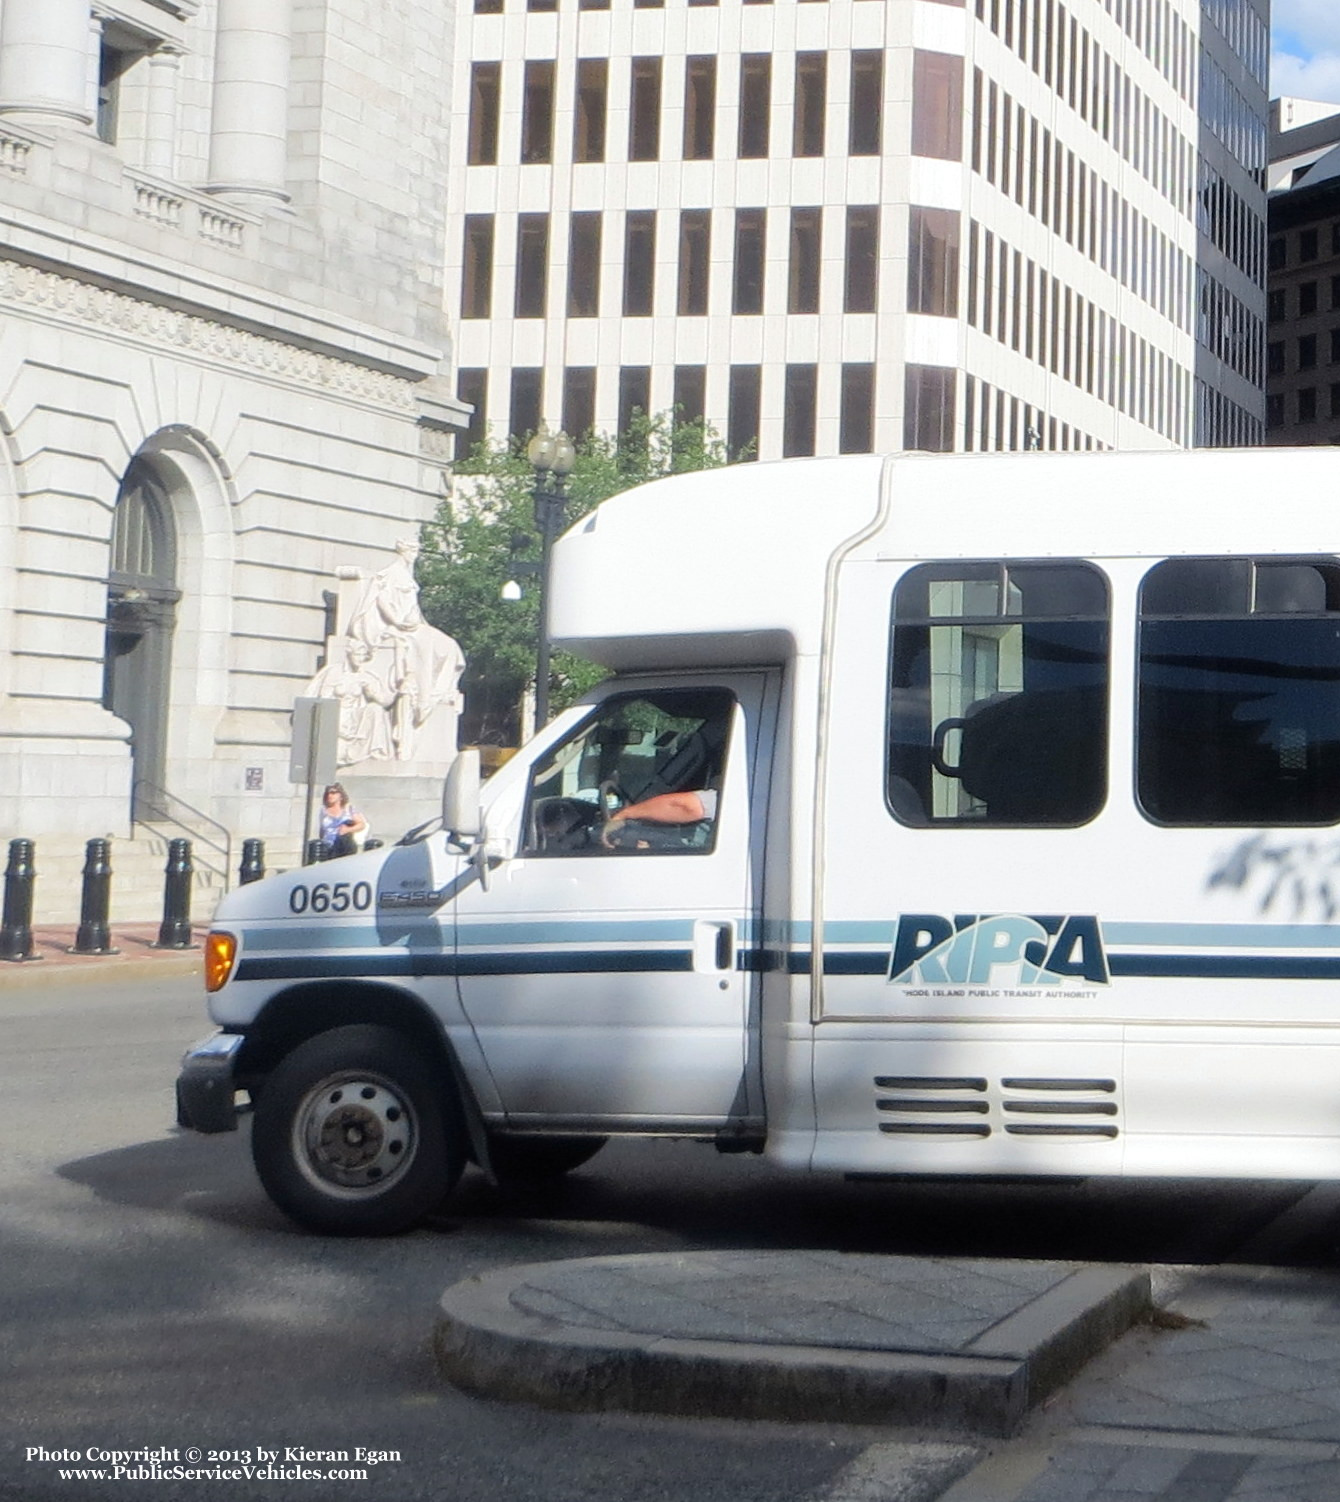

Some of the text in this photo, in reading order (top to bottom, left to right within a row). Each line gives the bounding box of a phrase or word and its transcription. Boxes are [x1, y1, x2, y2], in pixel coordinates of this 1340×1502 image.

[290, 881, 372, 914] 0650
[888, 913, 1110, 985] RIPTA
[932, 989, 966, 997] ISLAND
[1003, 990, 1042, 998] TRANSIT
[1045, 991, 1098, 999] AUTHORITY
